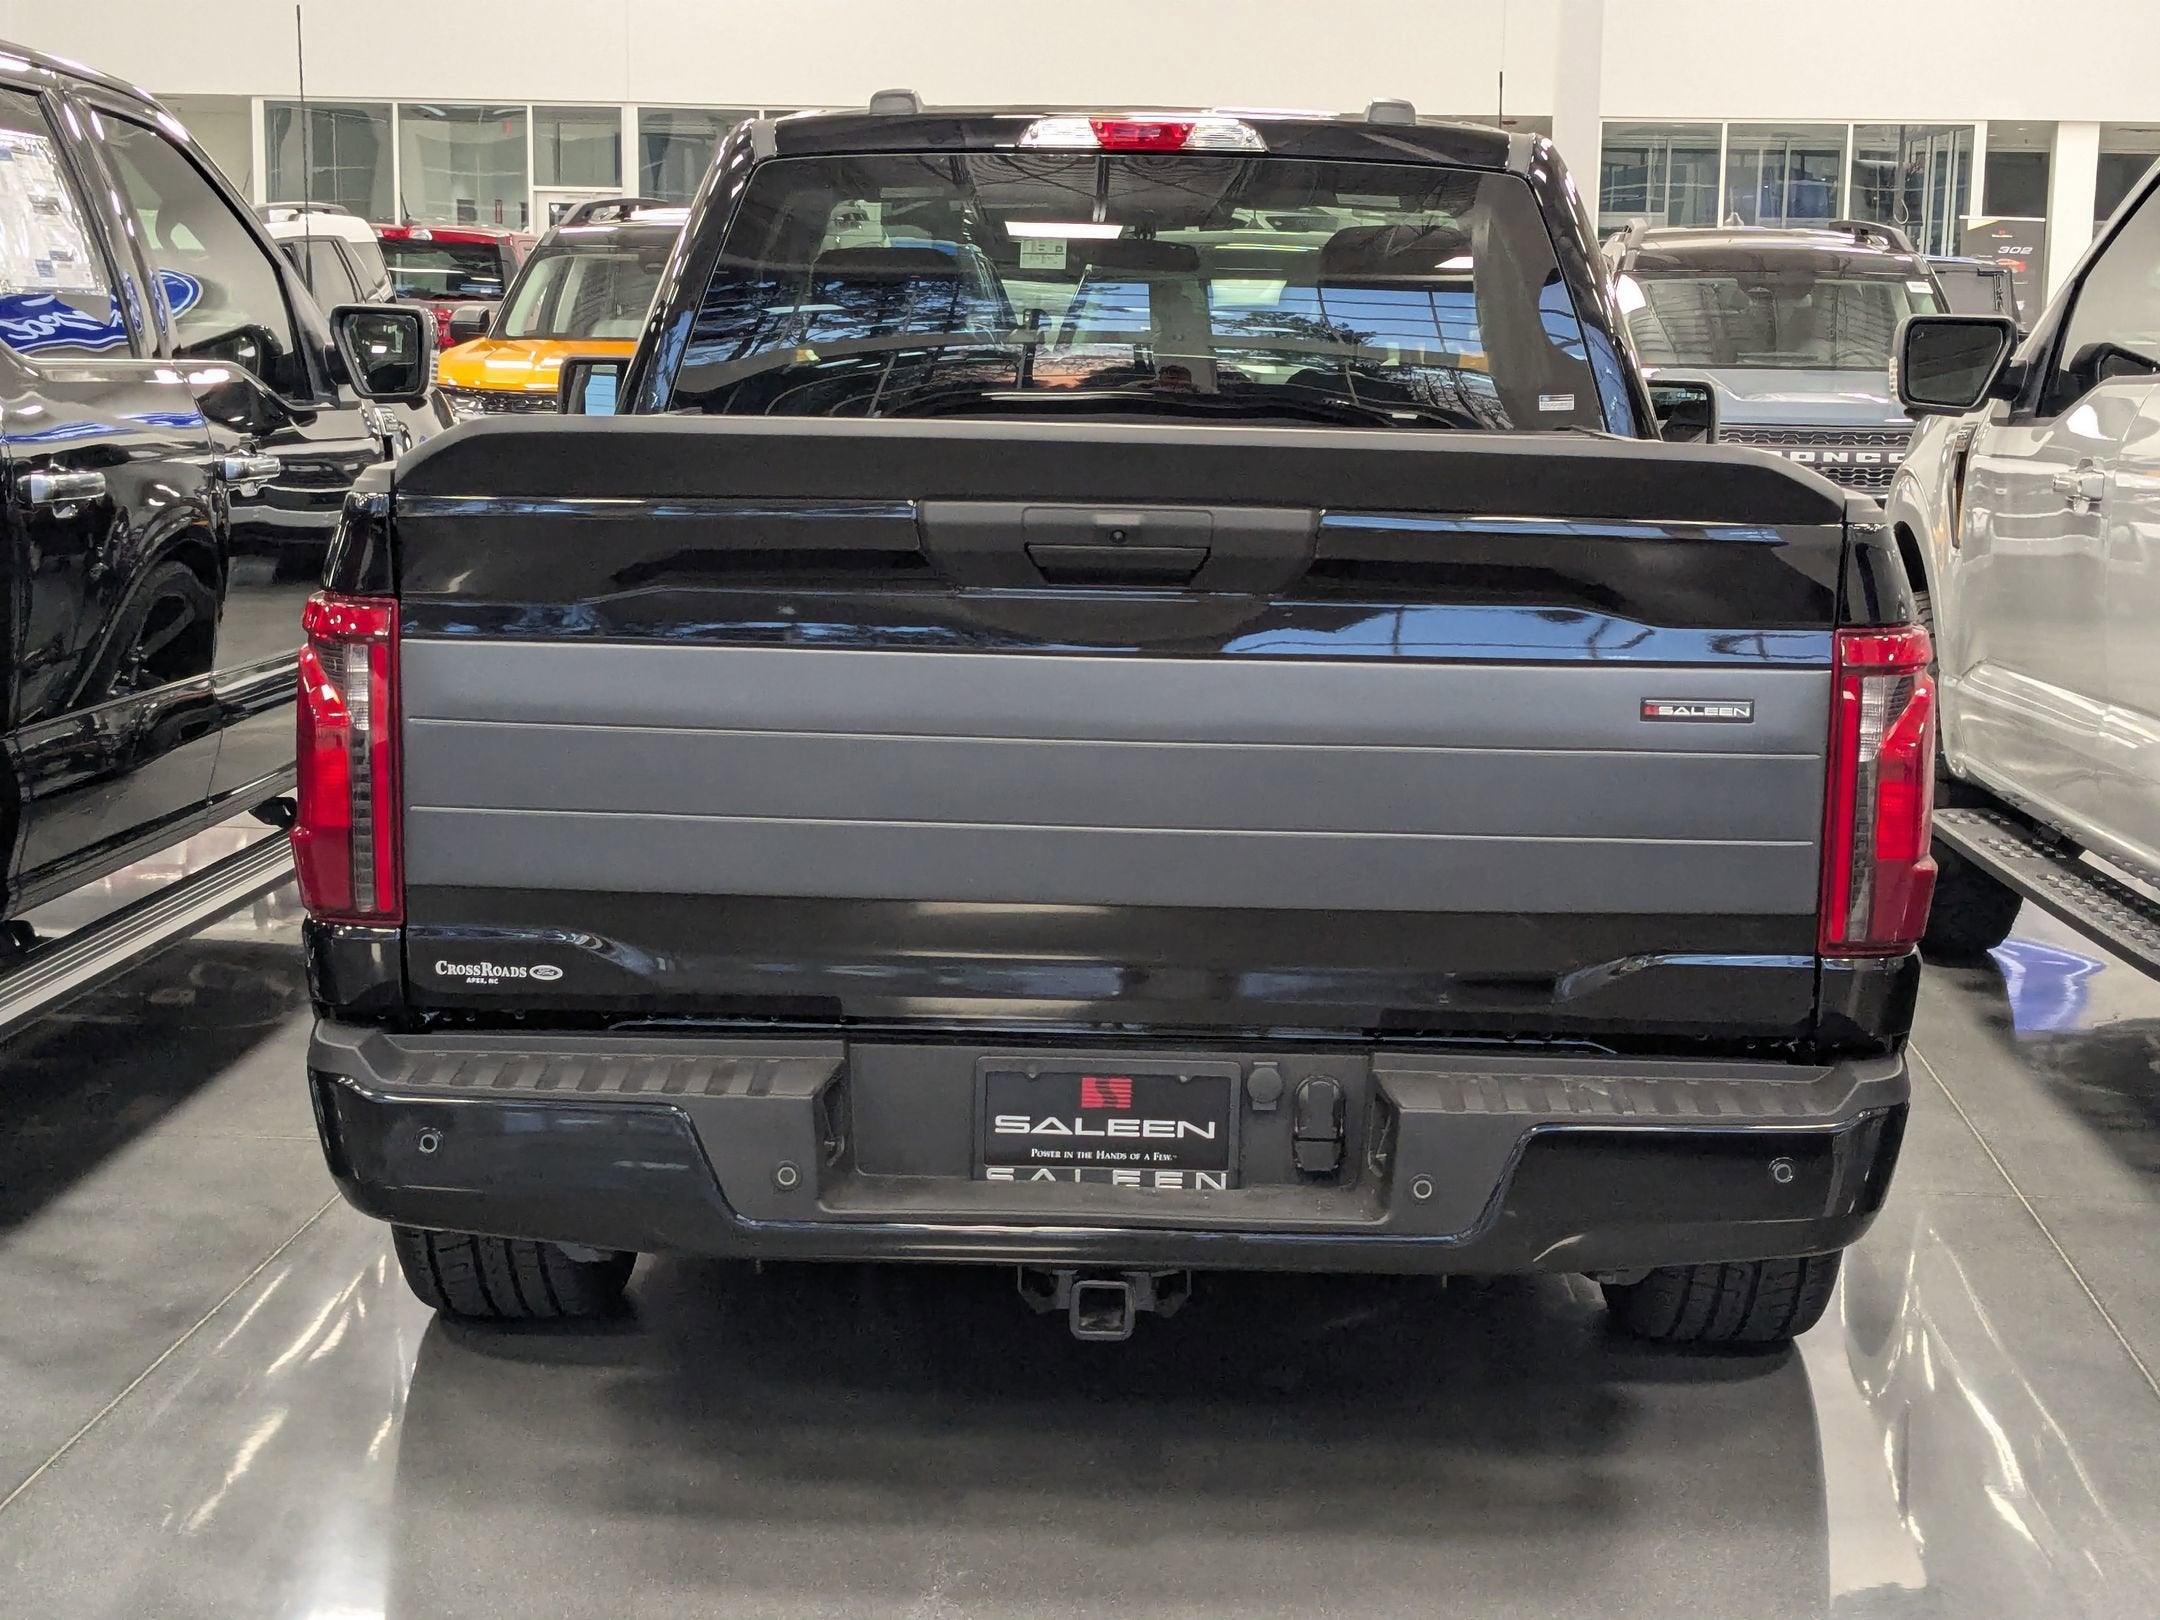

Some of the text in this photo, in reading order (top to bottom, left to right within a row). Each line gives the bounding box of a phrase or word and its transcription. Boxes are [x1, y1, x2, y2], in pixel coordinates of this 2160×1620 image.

[1998, 246, 2033, 255] 302
[1760, 450, 1907, 463] ONCO
[1658, 706, 1750, 718] SALEEN
[994, 1115, 1216, 1139] SALEEN
